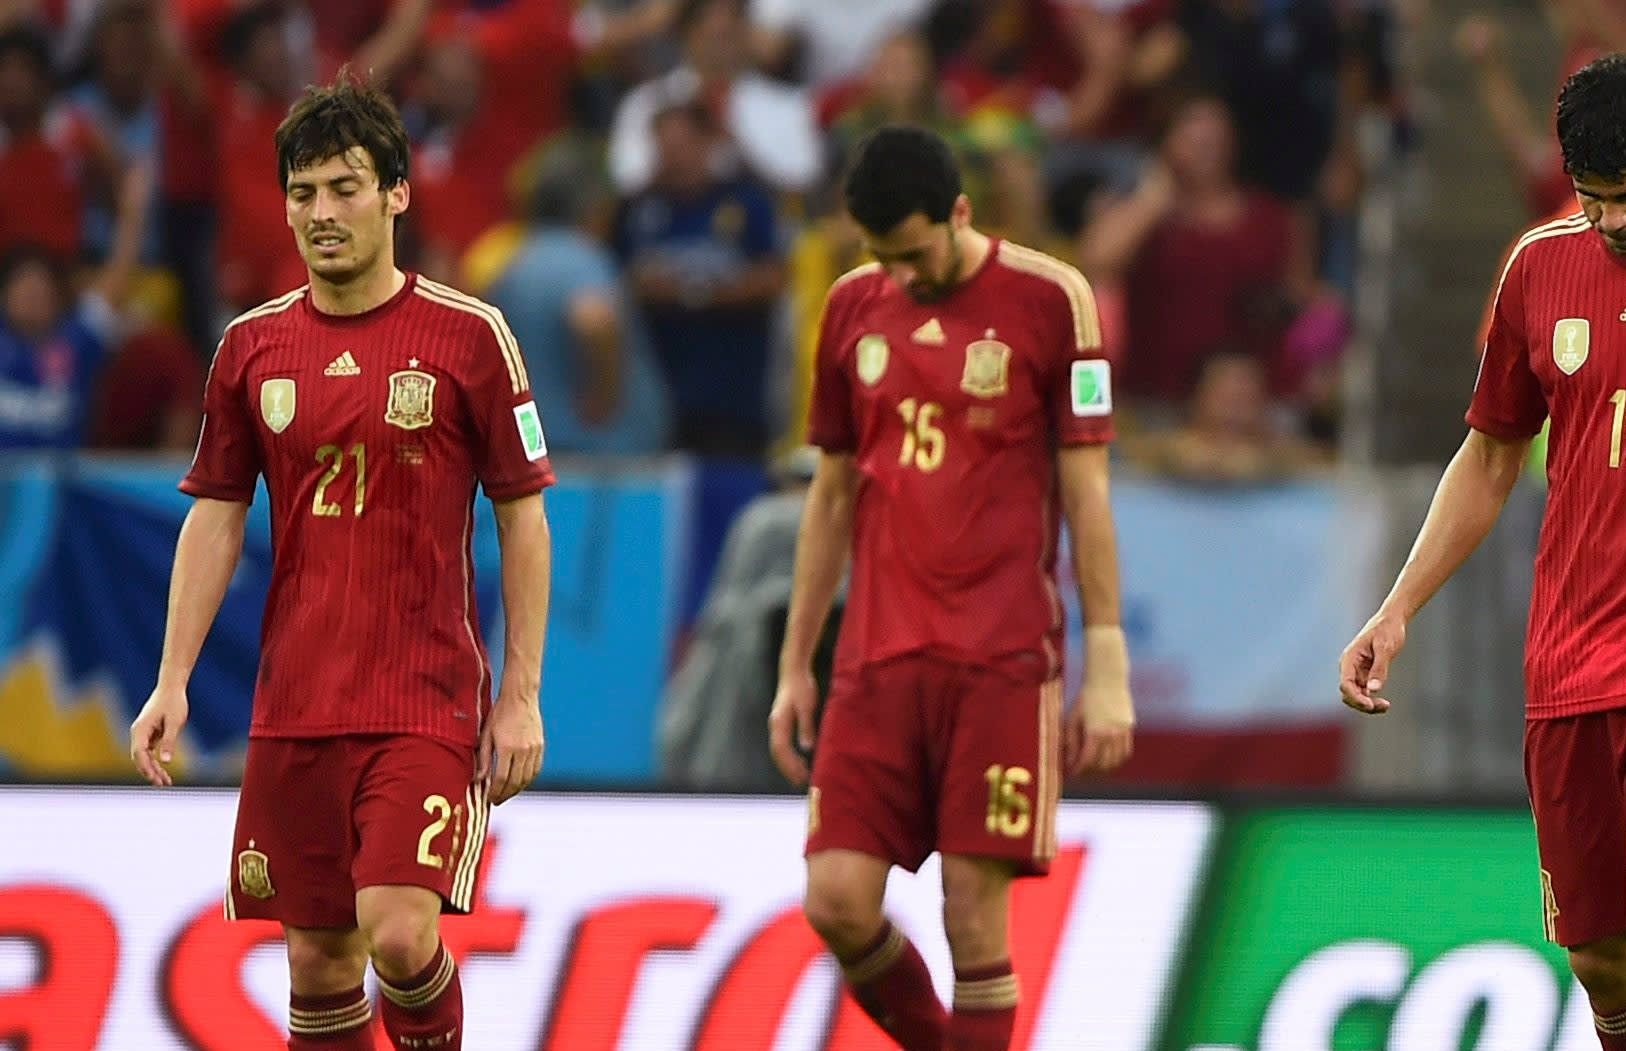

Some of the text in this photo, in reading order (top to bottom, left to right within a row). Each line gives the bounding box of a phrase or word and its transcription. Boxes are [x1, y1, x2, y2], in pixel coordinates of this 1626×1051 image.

[312, 443, 366, 518] 21
[417, 794, 463, 876] 21
[984, 764, 1032, 838] 16
